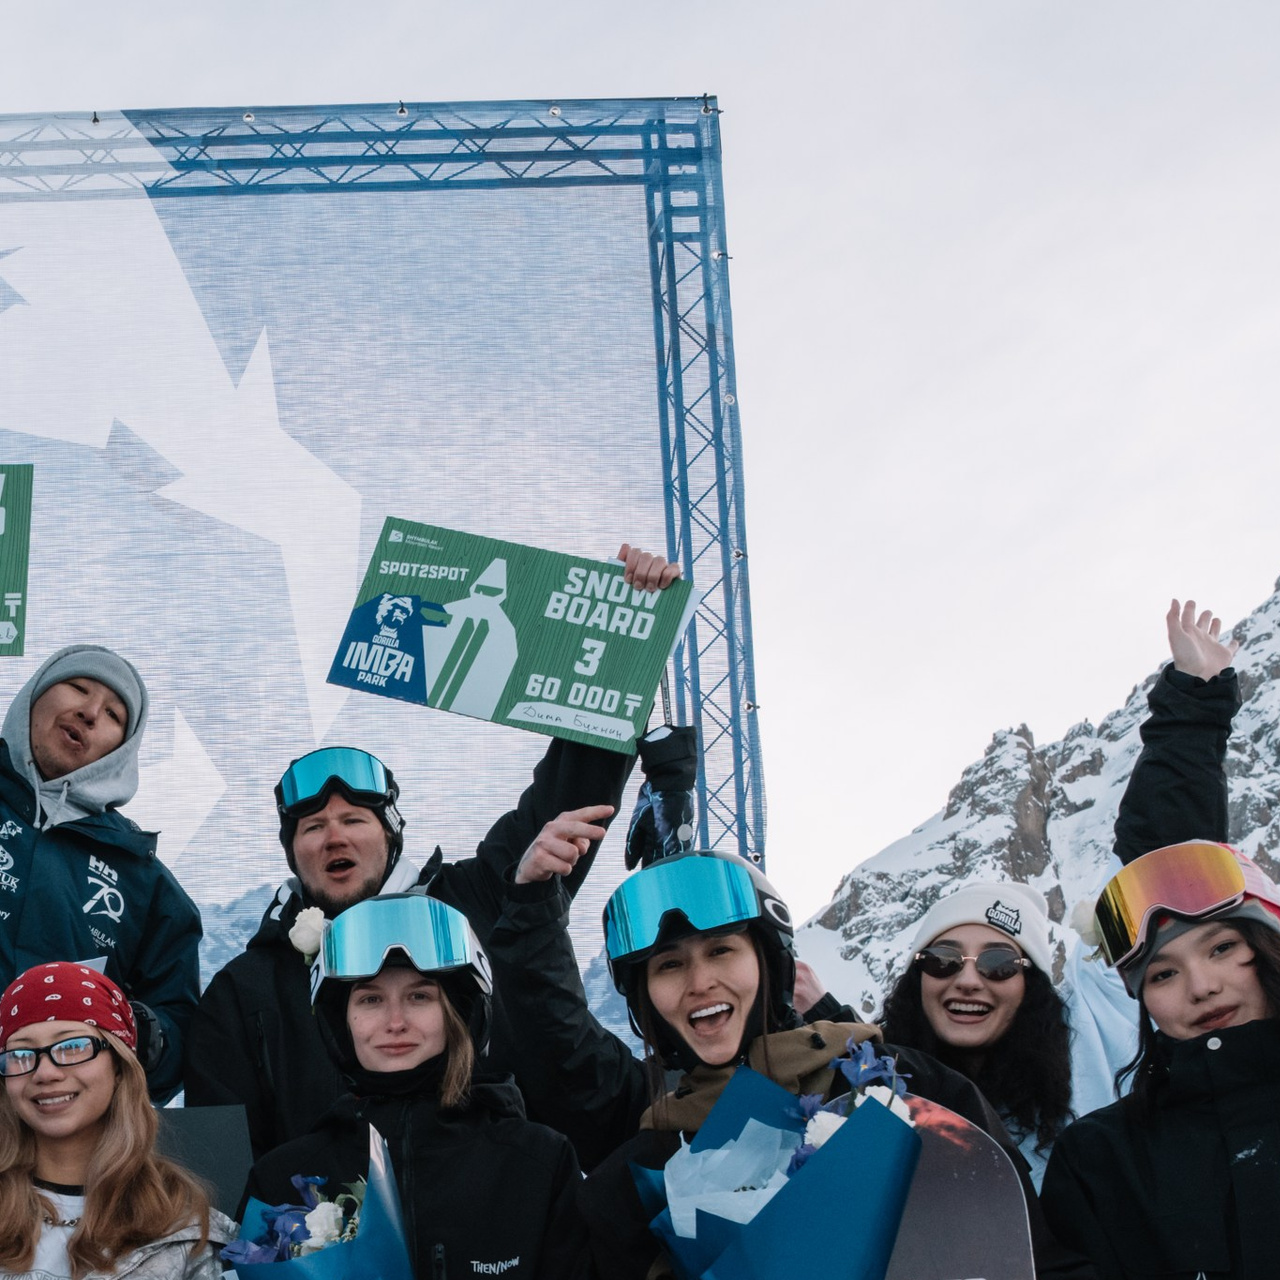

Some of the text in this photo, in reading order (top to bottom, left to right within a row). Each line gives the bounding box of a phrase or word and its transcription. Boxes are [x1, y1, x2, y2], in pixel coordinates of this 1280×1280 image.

[379, 561, 470, 581] SPOT2SPOT
[564, 567, 662, 609] SNOW
[544, 591, 656, 640] BOARD
[372, 634, 400, 648] GORILLA
[342, 642, 415, 683] IMBA
[574, 638, 607, 677] 3
[357, 671, 389, 688] PARK
[524, 673, 562, 700] 60
[987, 908, 1021, 931] GORILLA
